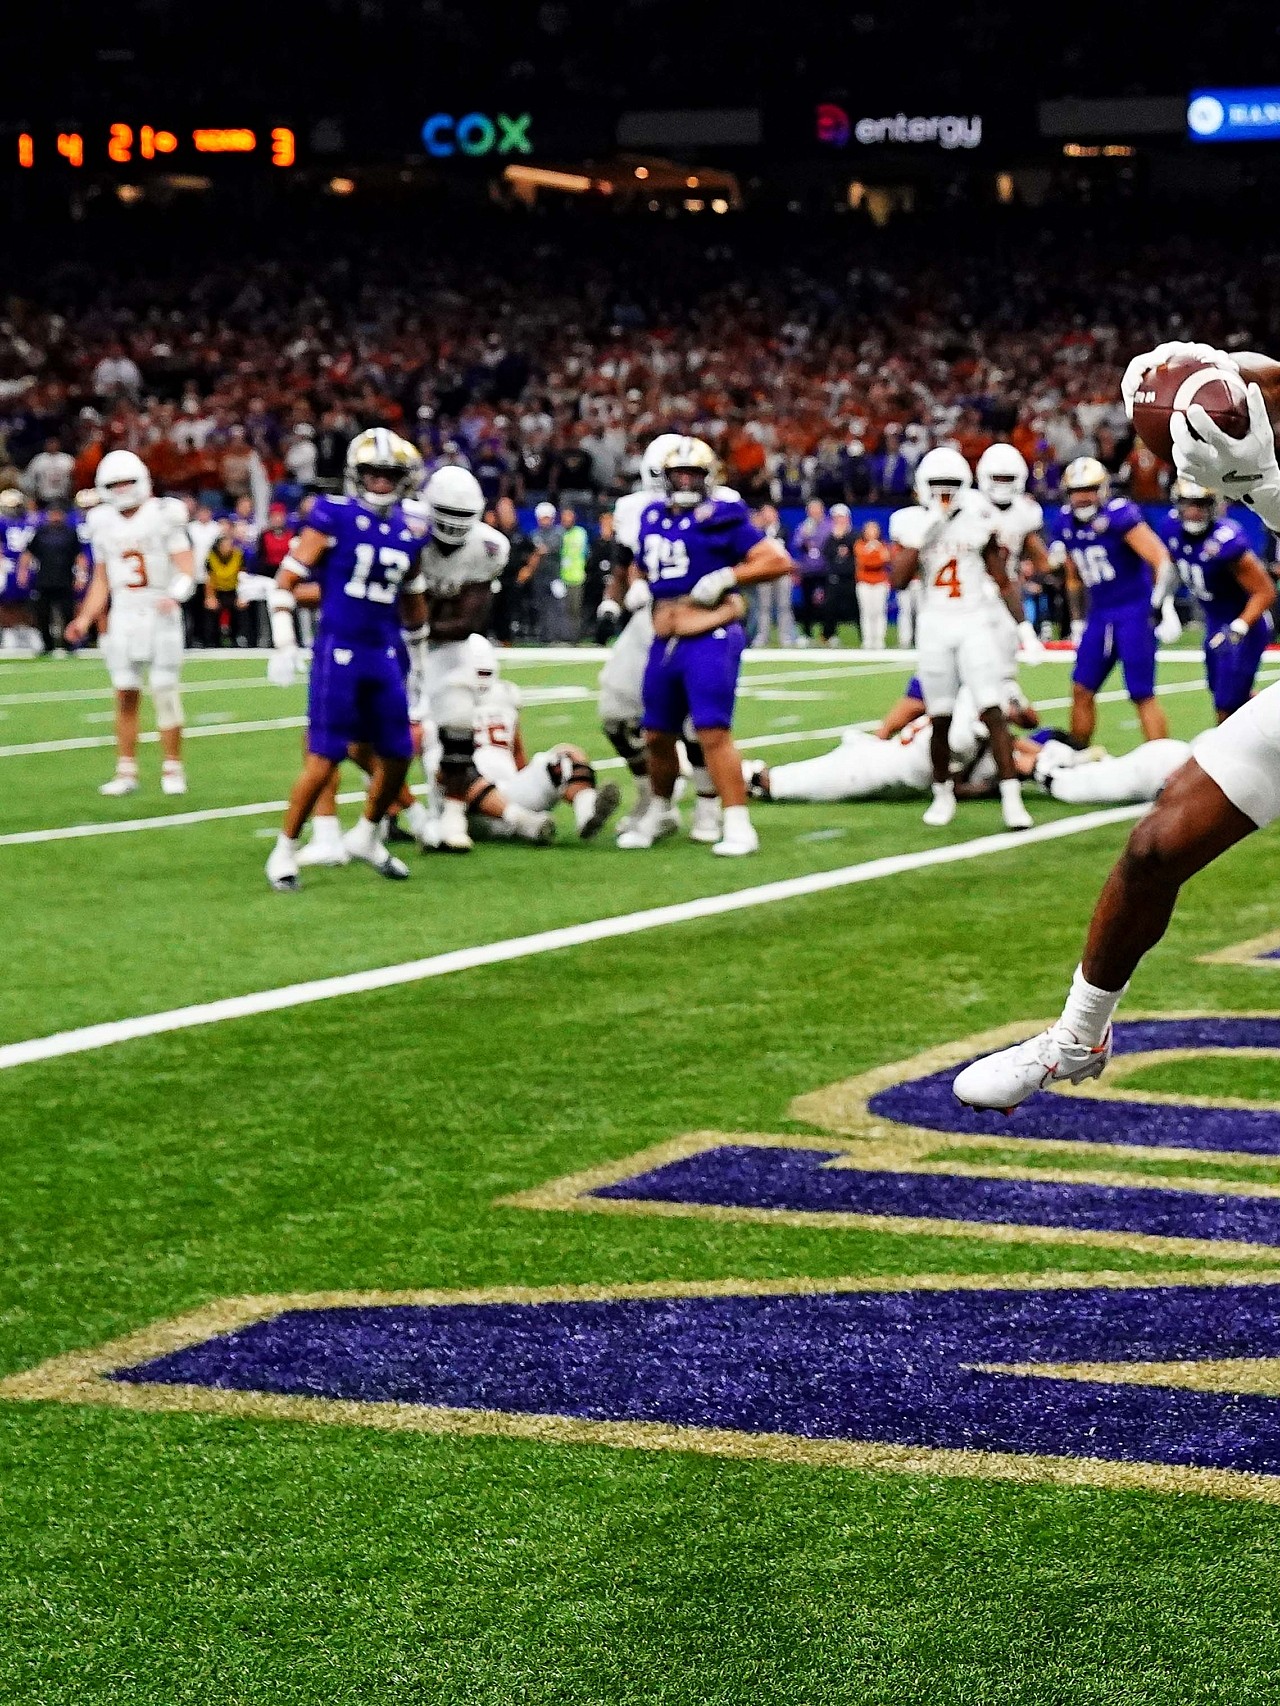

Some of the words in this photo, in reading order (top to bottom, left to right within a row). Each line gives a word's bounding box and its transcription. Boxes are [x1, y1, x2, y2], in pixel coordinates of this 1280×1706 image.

[421, 112, 533, 157] COX
[854, 112, 982, 149] entergy
[121, 550, 148, 589] 3
[344, 543, 411, 604] 13
[934, 558, 962, 598] 4
